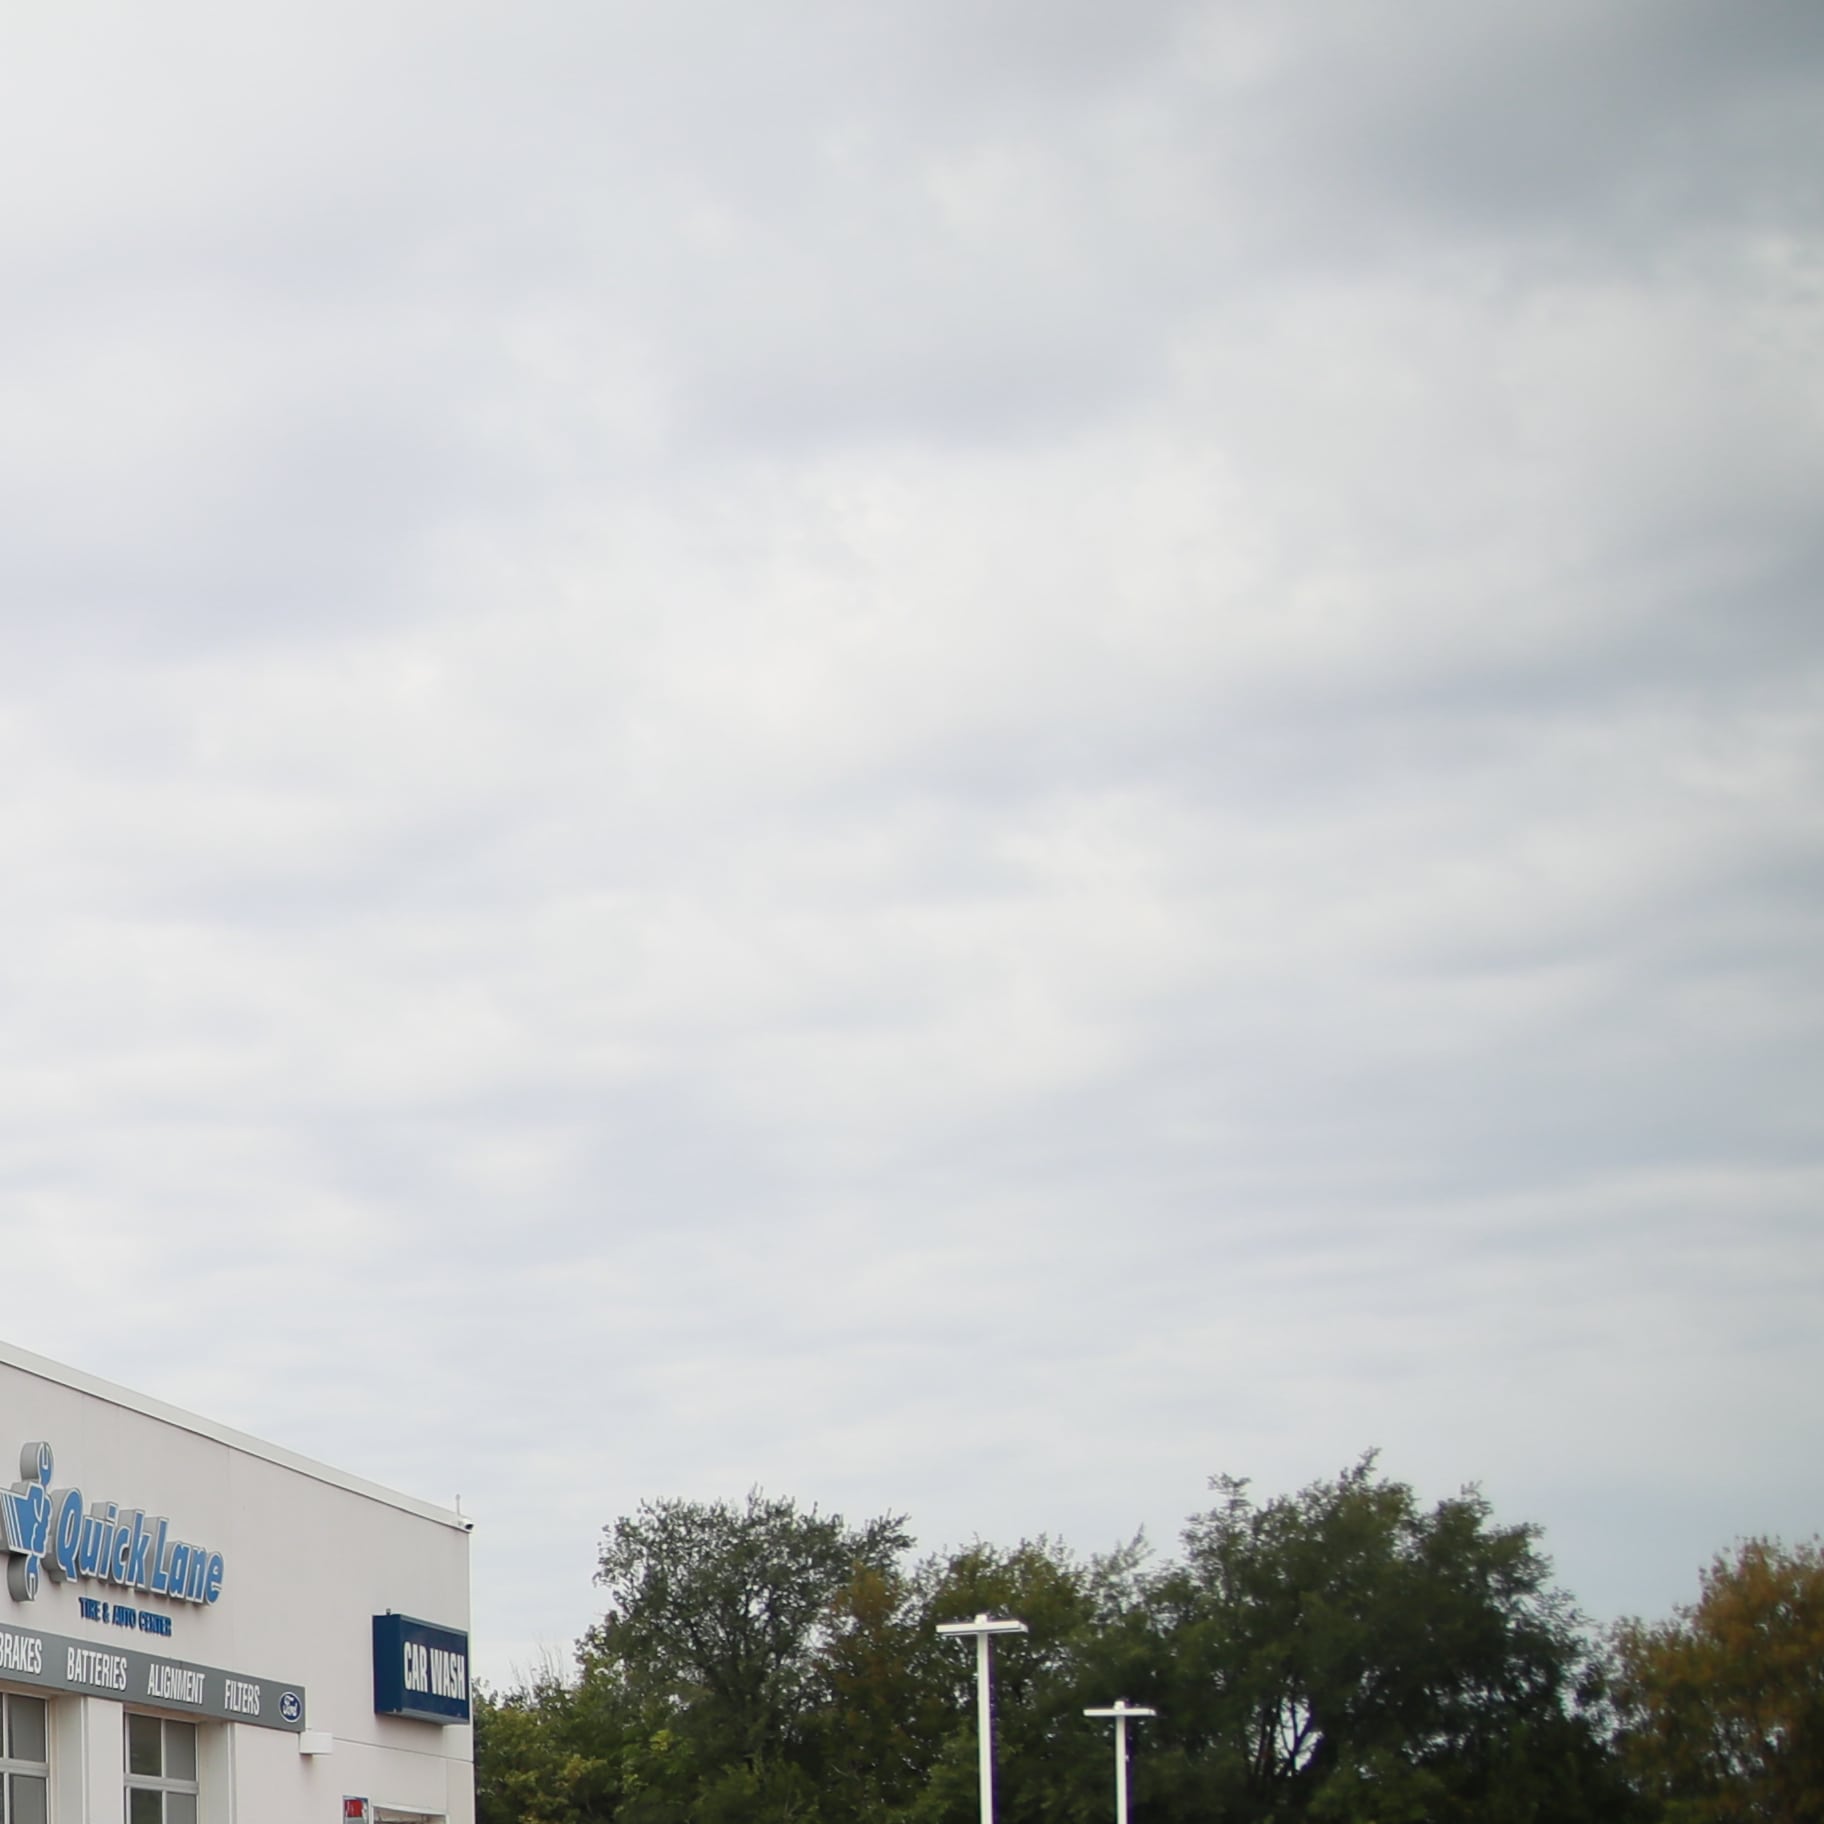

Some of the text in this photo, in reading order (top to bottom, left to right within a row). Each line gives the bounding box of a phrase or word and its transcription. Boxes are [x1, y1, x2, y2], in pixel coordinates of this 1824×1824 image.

[55, 1487, 225, 1606] Quick Lane
[78, 1597, 172, 1638] TIRE & AUTO CENTER
[66, 1647, 128, 1692] BATTERIES
[147, 1663, 206, 1705] ALIGNMENT
[224, 1678, 261, 1716] FILTERS
[403, 1640, 466, 1701] CAR WASH
